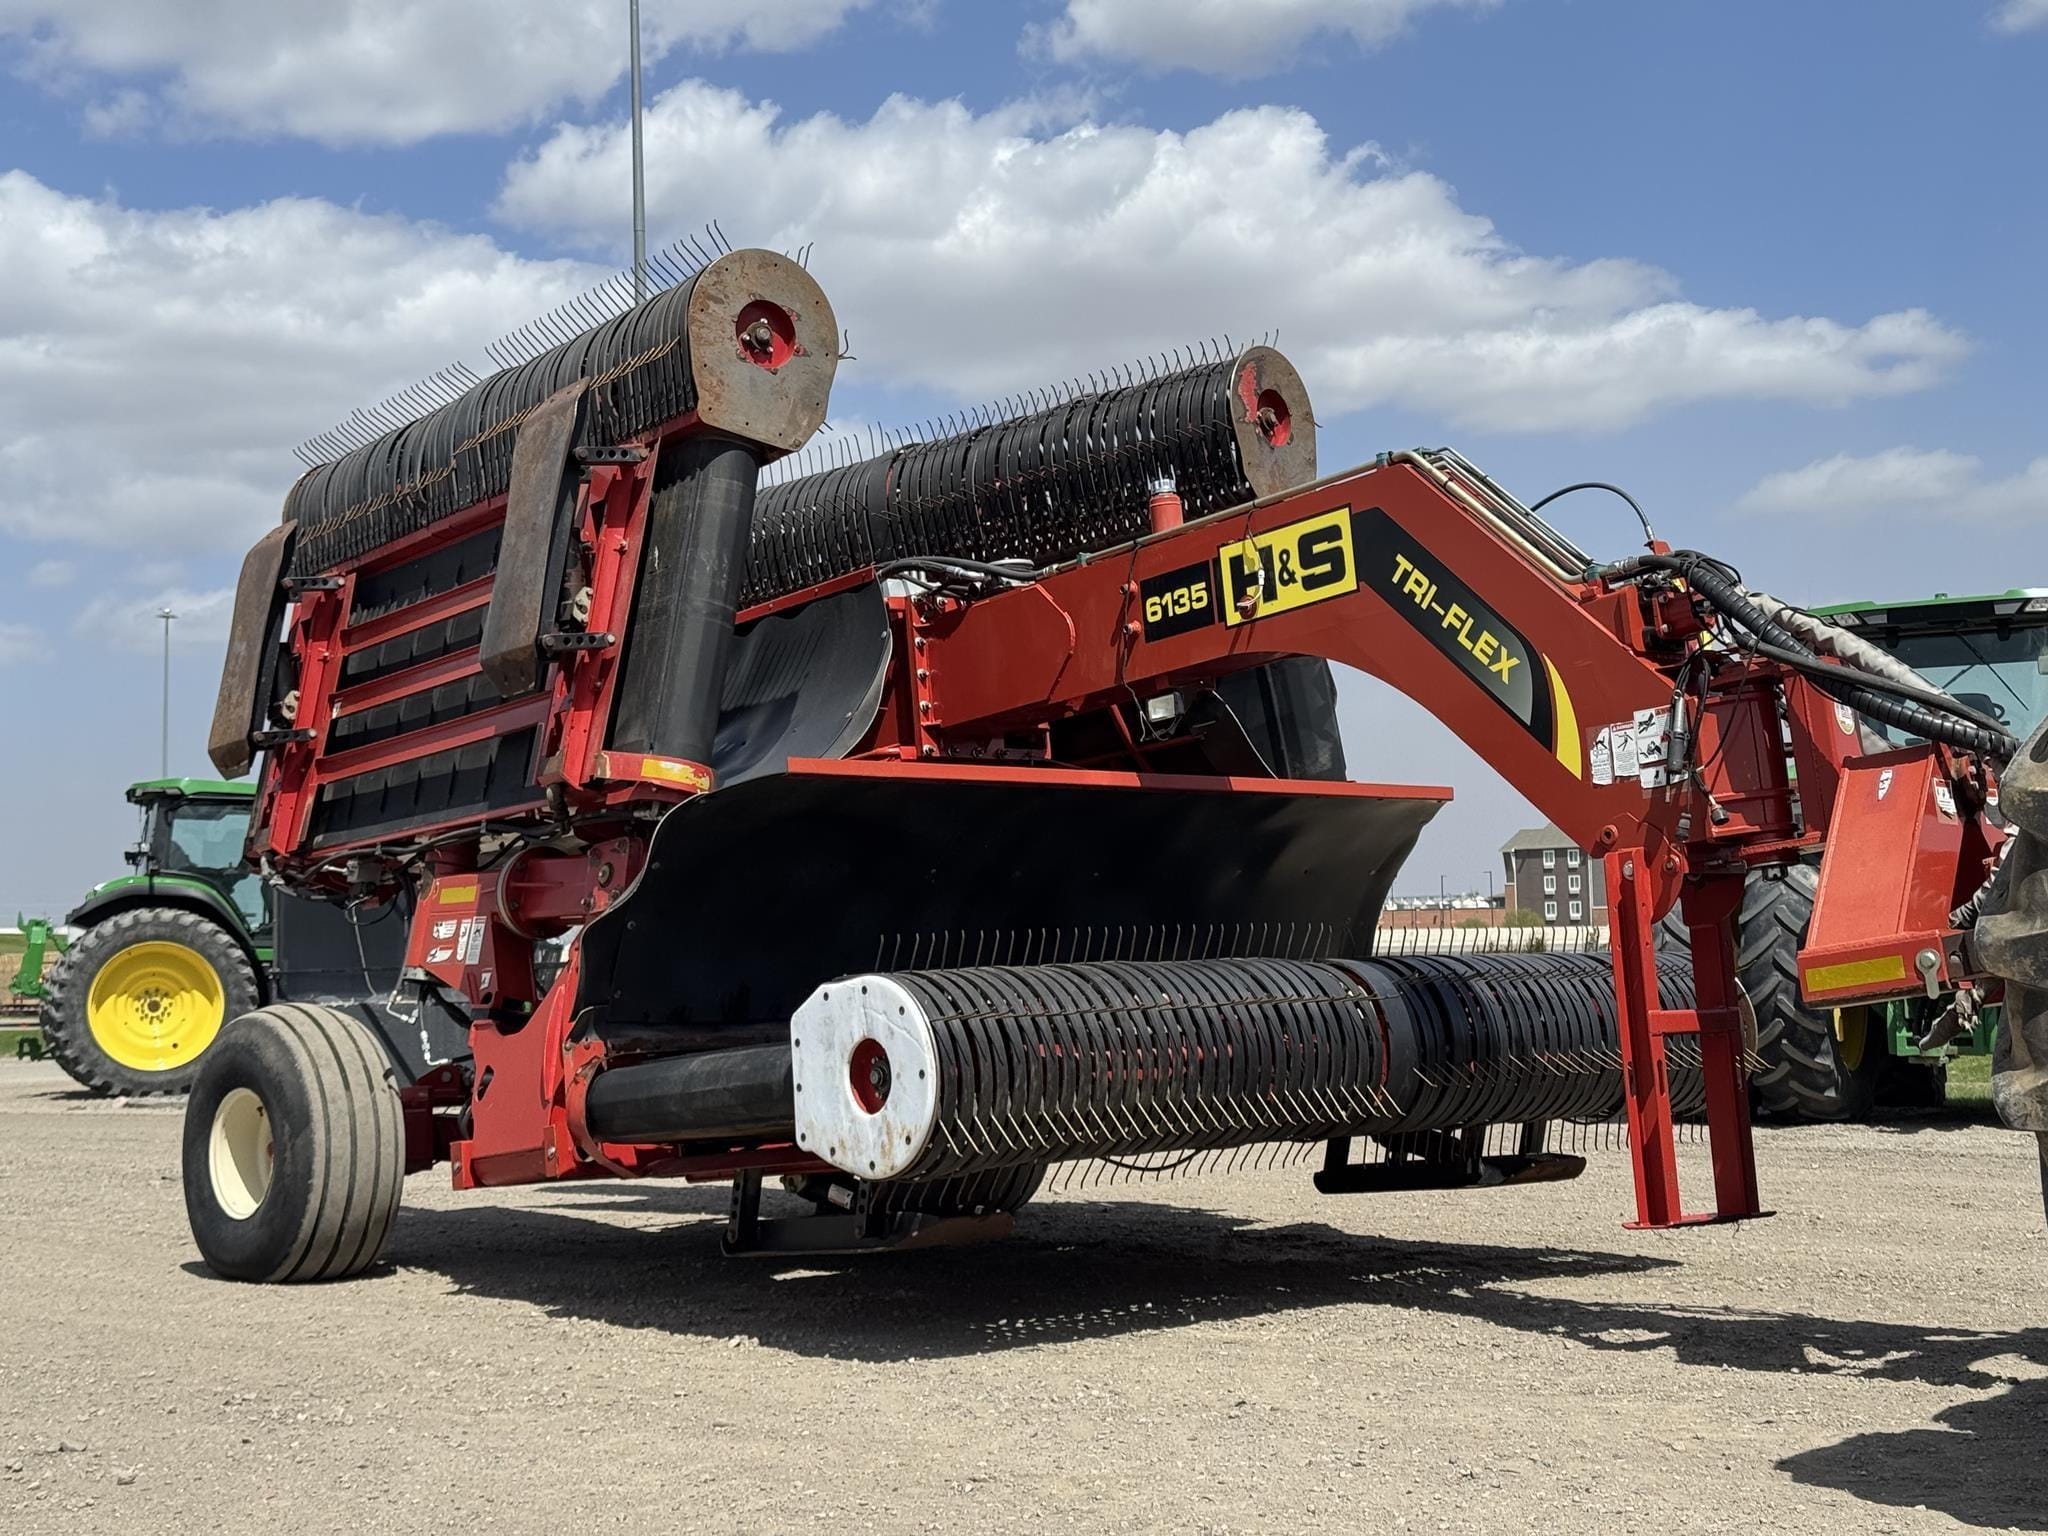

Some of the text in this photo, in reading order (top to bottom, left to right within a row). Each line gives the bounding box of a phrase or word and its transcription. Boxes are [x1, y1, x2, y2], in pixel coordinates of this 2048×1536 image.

[1145, 581, 1208, 623] 6135
[1229, 524, 1346, 613] H&S
[1391, 553, 1521, 685] TRI-FLEX
